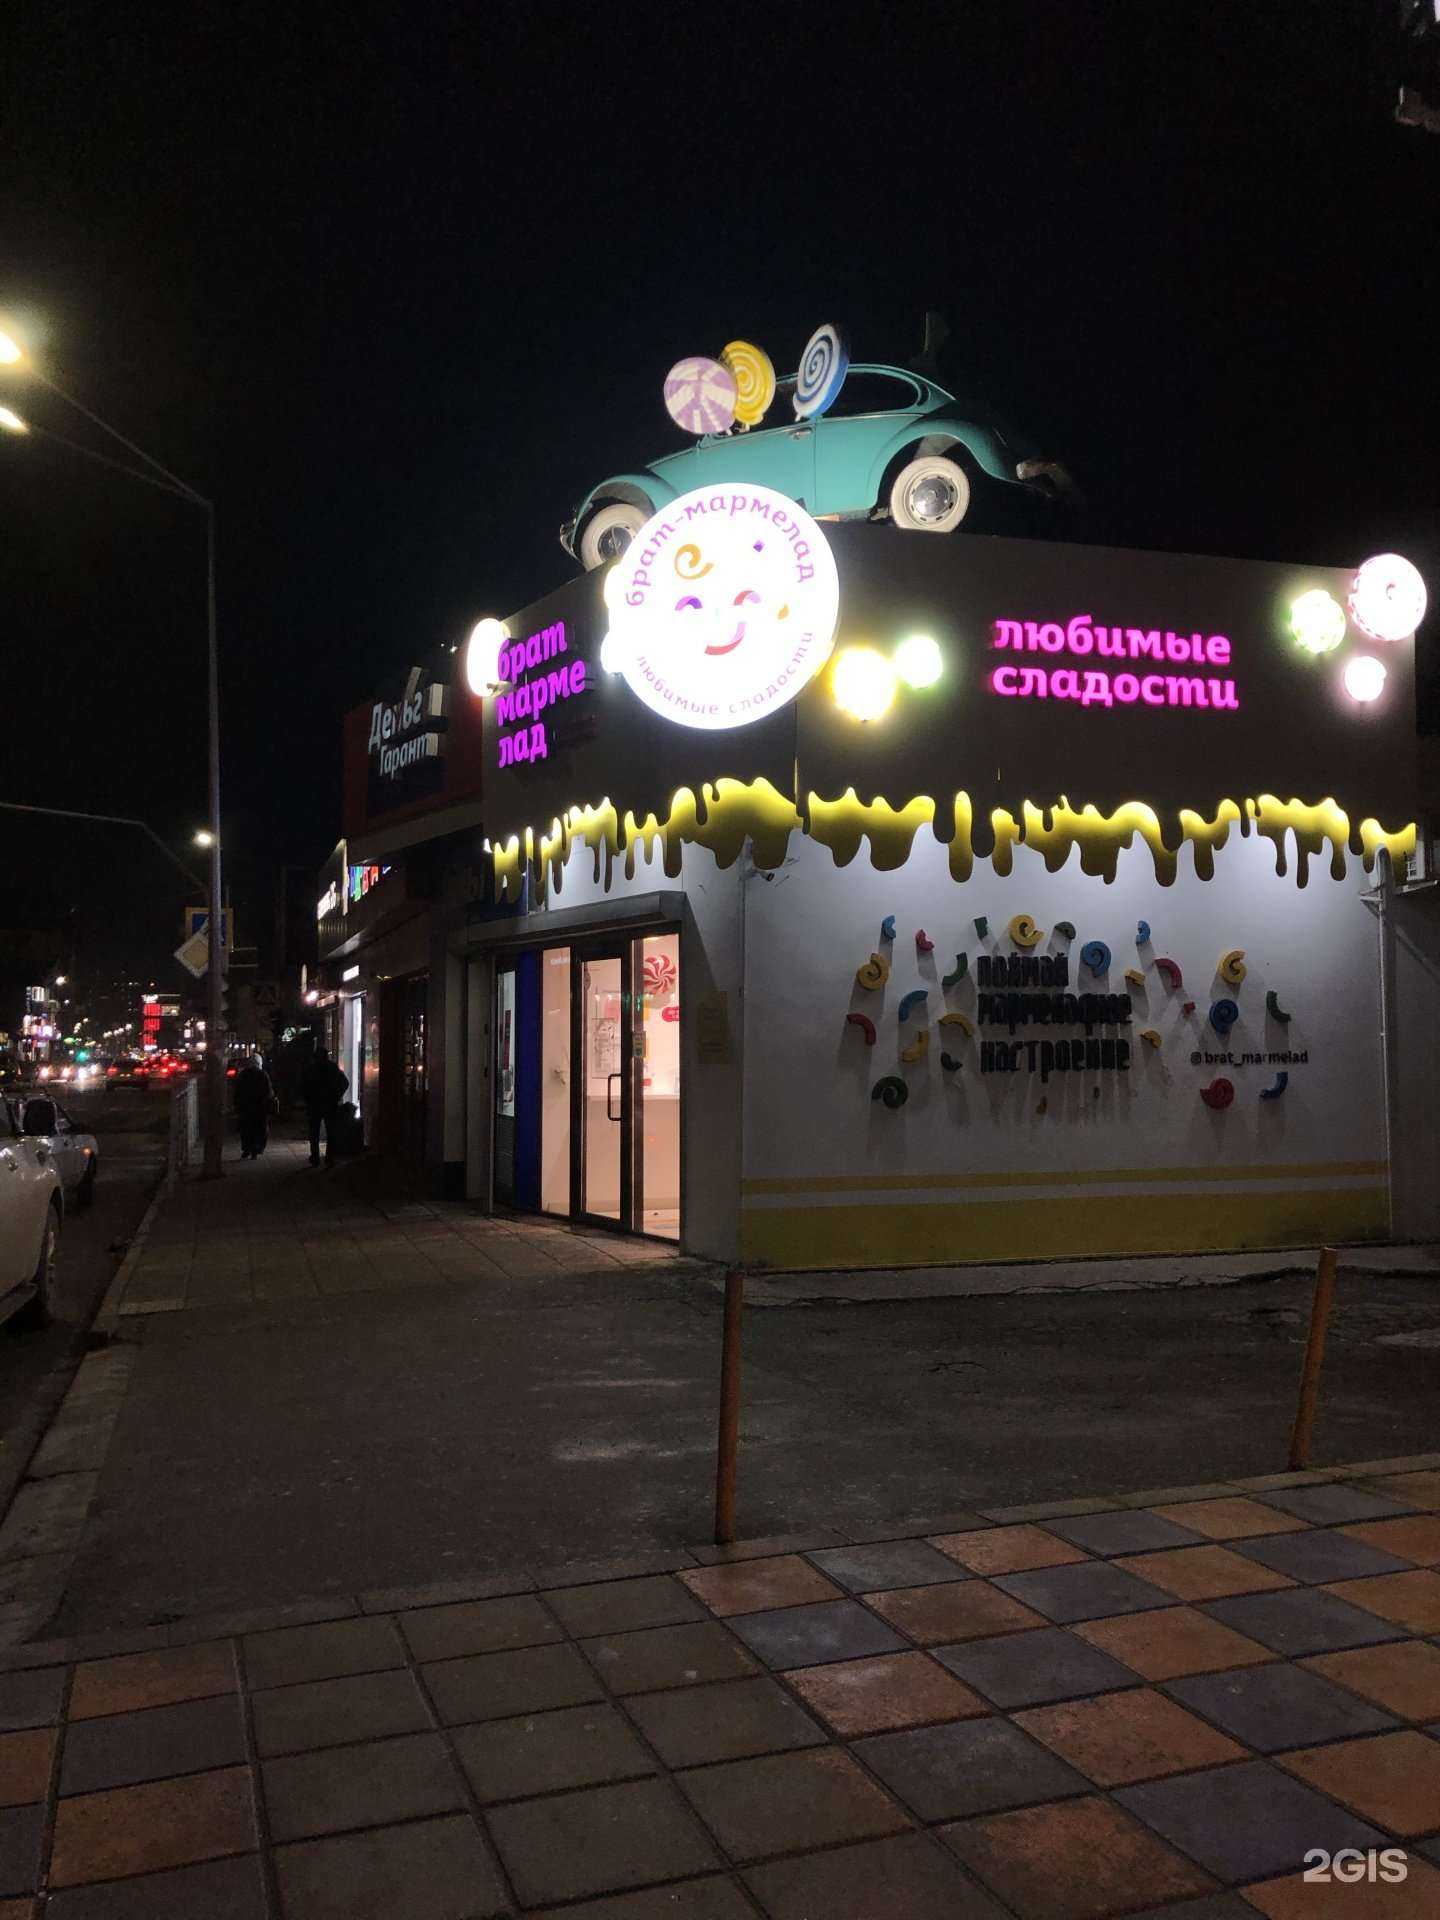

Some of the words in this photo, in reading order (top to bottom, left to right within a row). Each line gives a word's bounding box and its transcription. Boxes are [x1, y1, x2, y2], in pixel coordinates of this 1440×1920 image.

[625, 494, 815, 606] брат-мармелад
[497, 621, 568, 684] брат
[994, 614, 1231, 665] любимые
[497, 660, 586, 727] марме
[637, 655, 720, 715] любимые
[729, 631, 814, 713] сладости
[992, 666, 1239, 709] сладости
[497, 723, 548, 768] лад
